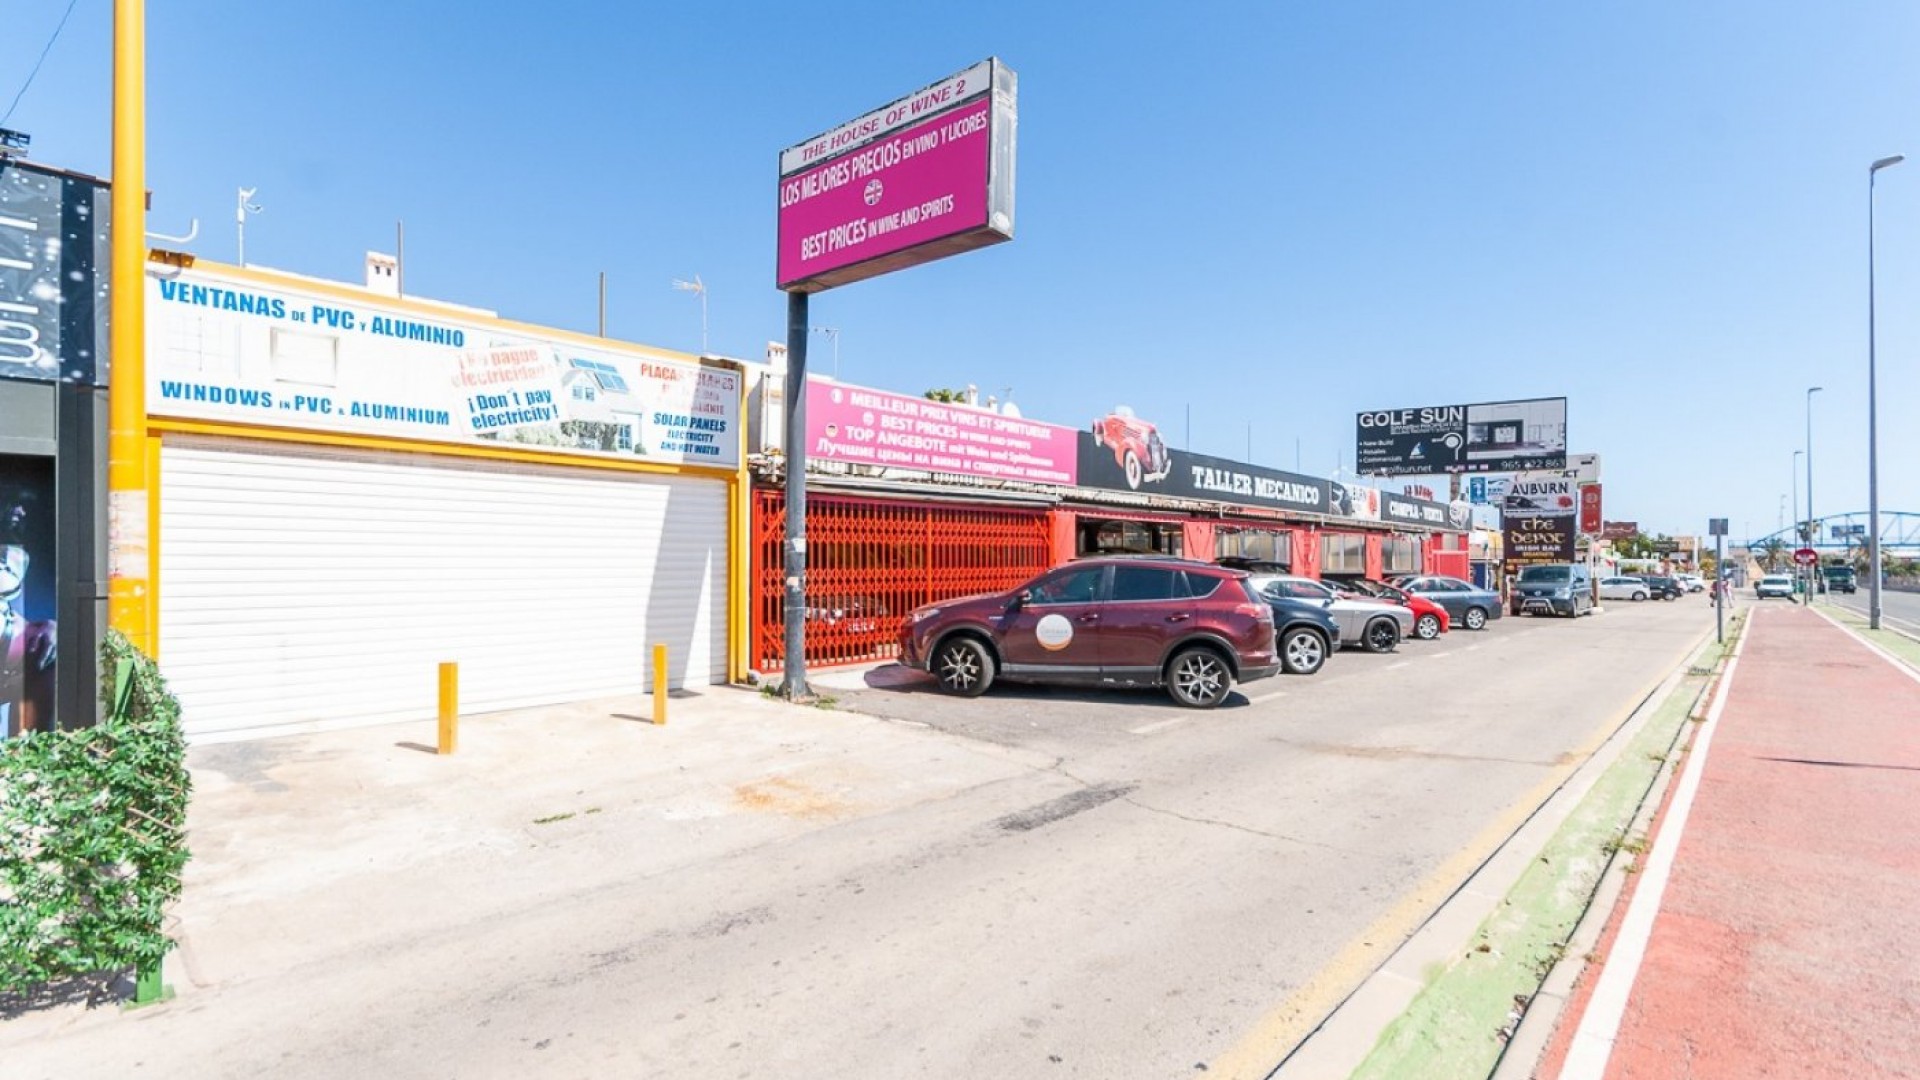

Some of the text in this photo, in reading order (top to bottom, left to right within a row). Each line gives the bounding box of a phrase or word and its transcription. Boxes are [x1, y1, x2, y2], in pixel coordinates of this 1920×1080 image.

[803, 79, 966, 162] THE HOUSE OF WINE 2
[780, 110, 987, 209] LOS MEJORES PRECIOS EN VINO Y LICORES
[801, 194, 954, 261] BEST PRICES IN WINE AND SPIRITS
[160, 278, 465, 348] VENTANAS DE PVC Y ALUMINIO
[641, 363, 686, 381] PLACA
[161, 380, 272, 408] WINDOWS
[279, 400, 290, 410] IN
[295, 395, 332, 414] PVC
[351, 401, 450, 426] ALUMINIUM
[526, 389, 552, 406] pay
[850, 391, 918, 417] MEILLEUR
[920, 405, 948, 421] PRIX
[949, 410, 978, 427] VINS
[979, 415, 992, 428] ET
[653, 412, 727, 433] SOLAR PANELS
[881, 414, 914, 431] BEST
[916, 421, 958, 438] PRICES
[1360, 409, 1414, 428] GOLF
[1420, 406, 1464, 424] SUN
[667, 429, 714, 443] ELECTRICITY
[816, 437, 875, 457] Лучшие
[845, 425, 875, 442] TOP
[877, 431, 946, 453] ANGEBOTE
[1191, 465, 1253, 496] TALLER
[1255, 476, 1319, 505] MECANICO
[1511, 481, 1569, 496] AUBURN
[1514, 544, 1562, 552] IRISH BAR
